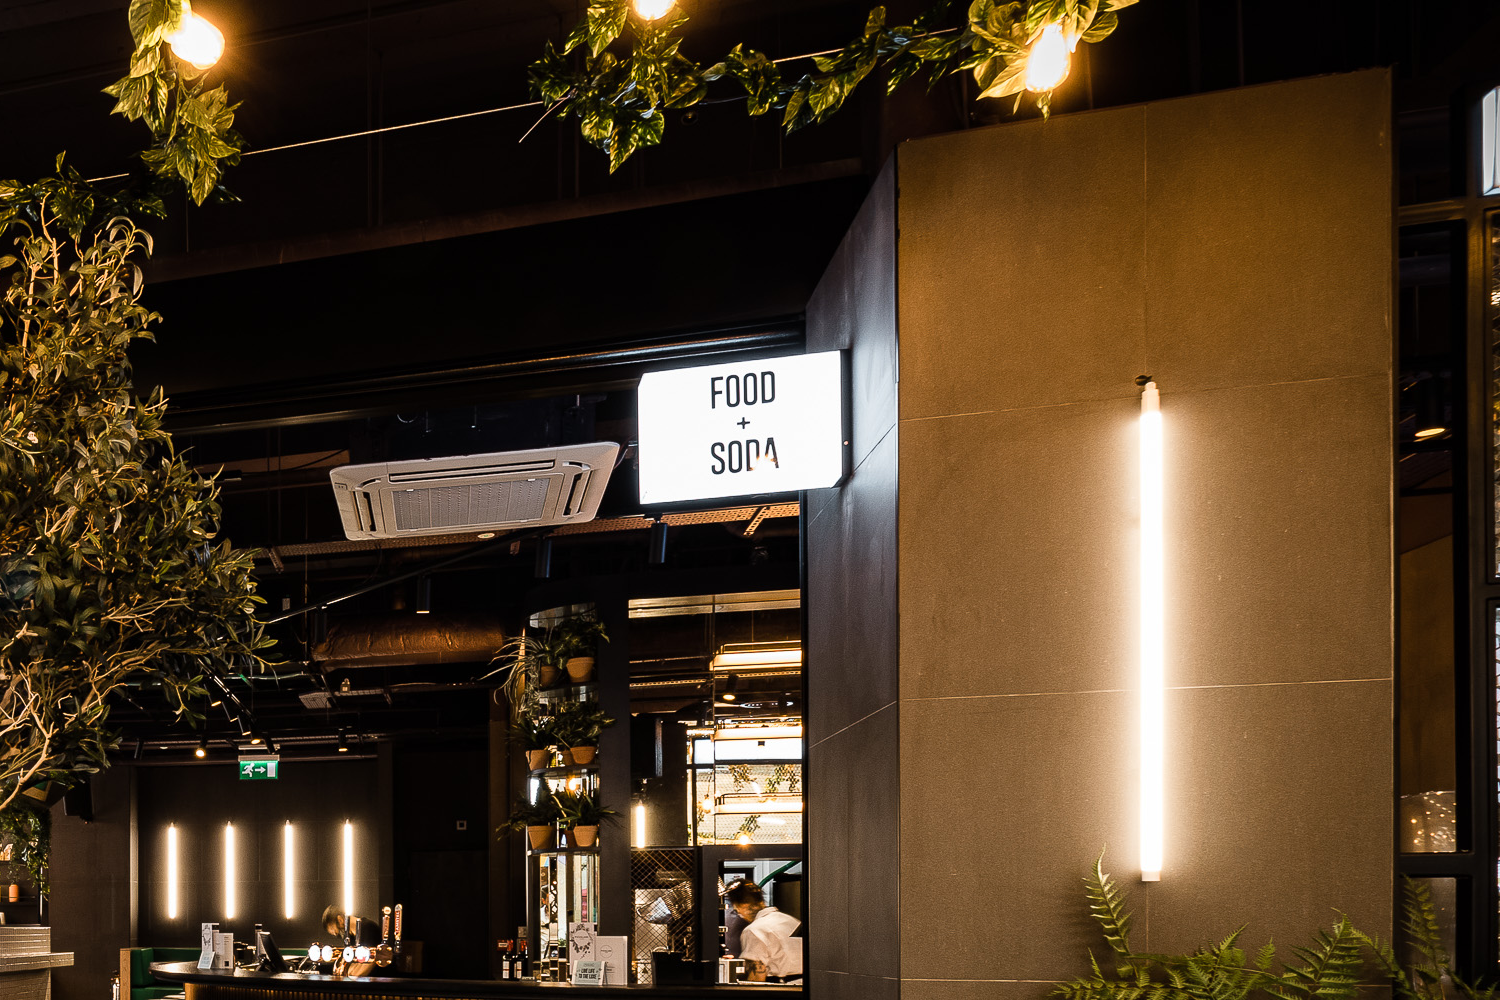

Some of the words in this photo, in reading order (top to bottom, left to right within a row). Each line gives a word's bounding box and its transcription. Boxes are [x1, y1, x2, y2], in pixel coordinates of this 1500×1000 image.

[710, 370, 776, 410] FOOD
[736, 416, 751, 430] +
[710, 436, 780, 475] SODA
